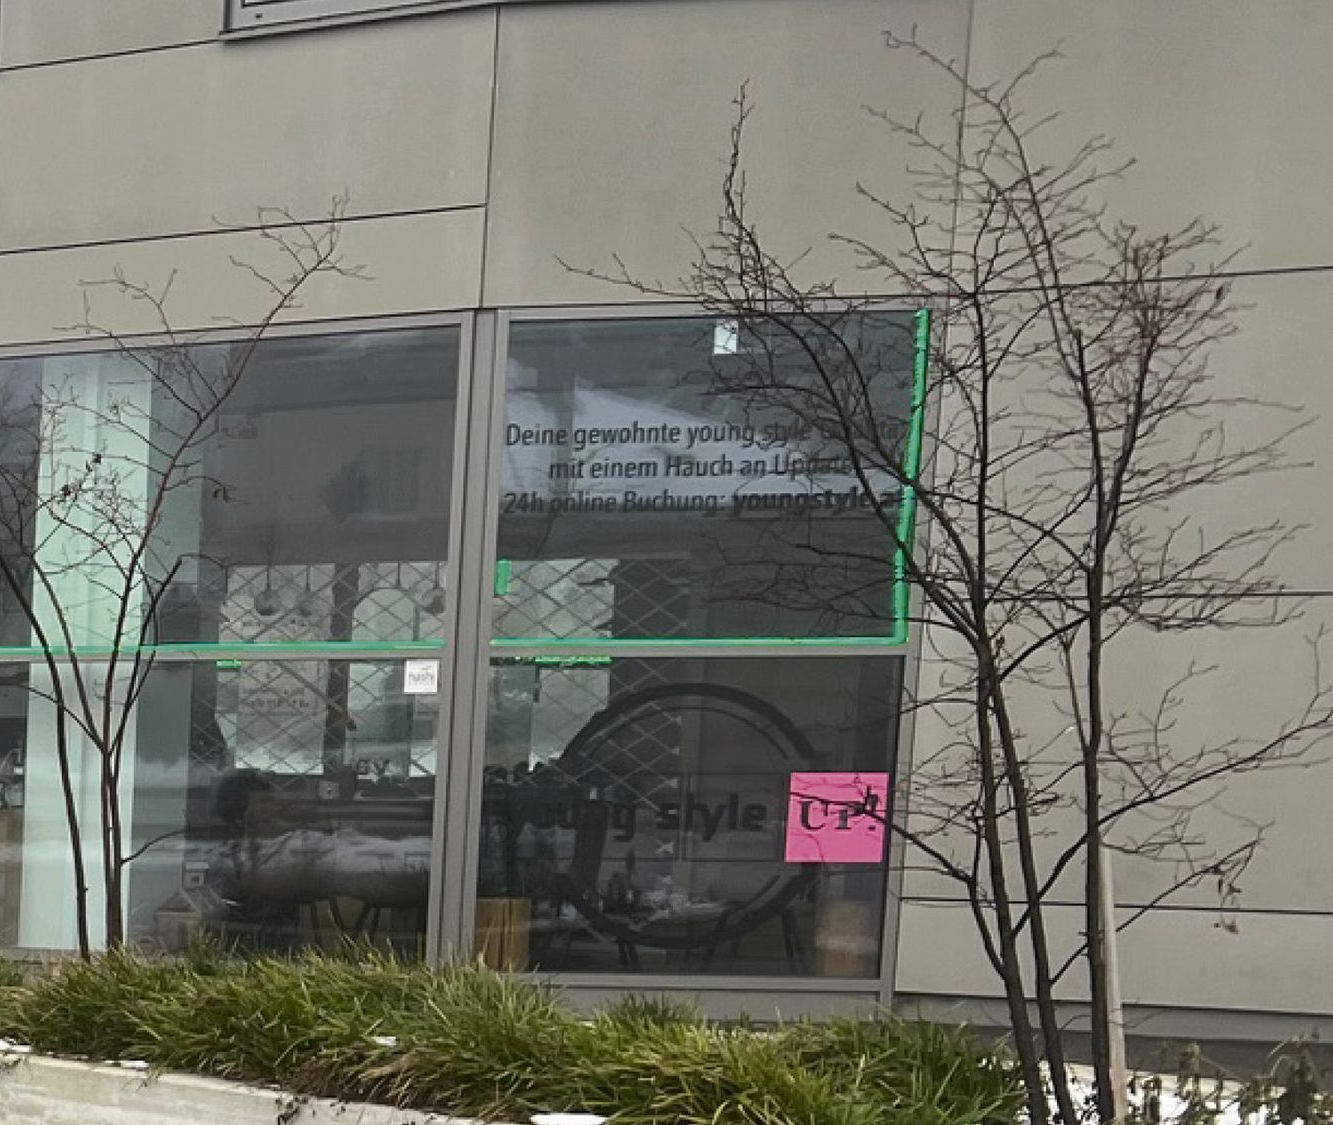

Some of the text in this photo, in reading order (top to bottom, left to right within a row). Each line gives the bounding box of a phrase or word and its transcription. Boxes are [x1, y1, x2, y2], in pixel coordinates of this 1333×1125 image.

[505, 423, 568, 446] Deine
[573, 421, 681, 451] gewohnte
[685, 422, 755, 448] young
[548, 457, 584, 478] mit
[589, 456, 658, 478] einem
[664, 454, 733, 477] Hauch
[739, 458, 767, 477] an
[504, 491, 543, 514] 24h
[550, 490, 617, 513] online
[623, 489, 726, 515] Buchung:
[656, 792, 768, 842] style
